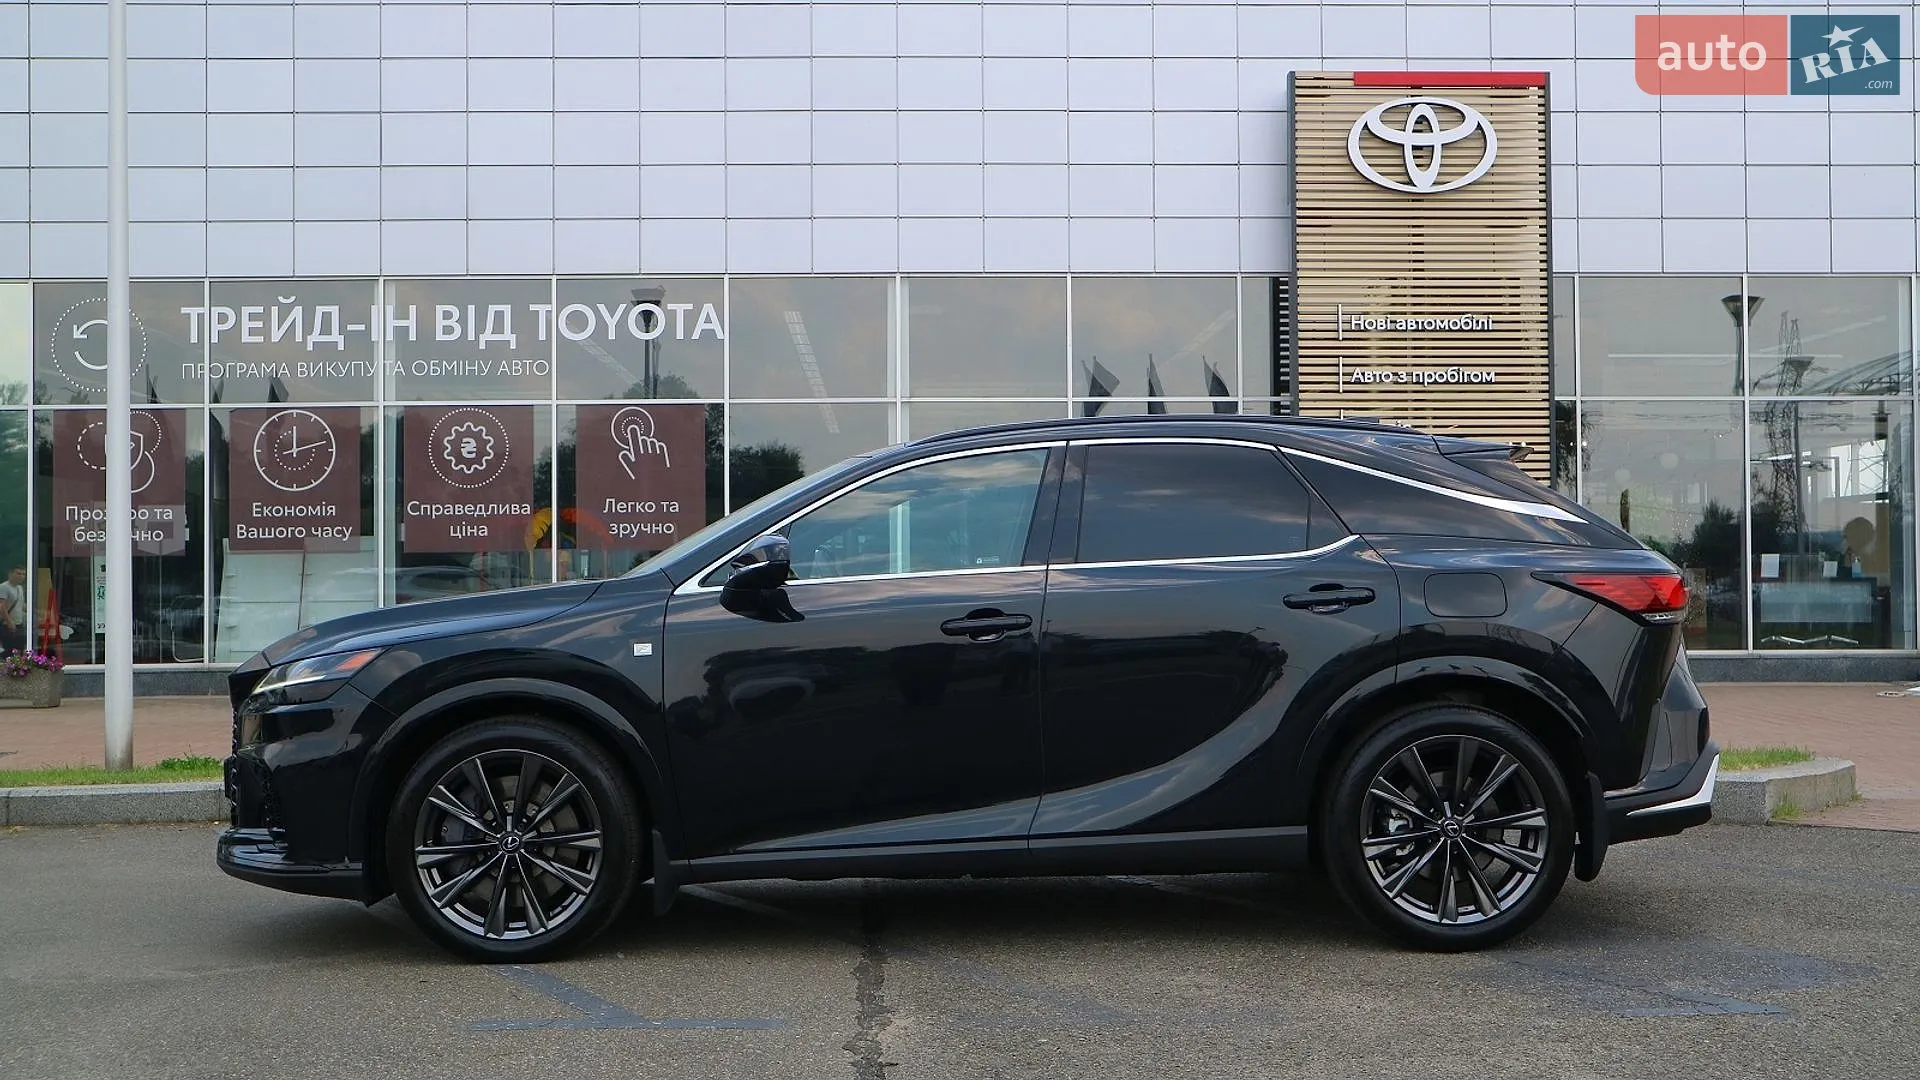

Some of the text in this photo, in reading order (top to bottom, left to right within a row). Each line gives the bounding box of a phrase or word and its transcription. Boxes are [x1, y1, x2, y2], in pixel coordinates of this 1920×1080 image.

[181, 295, 725, 351] ТРЕЙД-ІН ВІД TOYOTA
[1351, 314, 1493, 330] Нові автомобілі
[182, 359, 550, 379] ПРОГРАМА ВИКУПУ ТА ОБМІНУ АВТО
[1351, 366, 1496, 387] Авто з пробігом
[65, 505, 173, 524] Проо та
[252, 501, 336, 518] Економія
[406, 500, 531, 519] Справедлива
[603, 498, 680, 513] Легко та
[74, 526, 165, 542] безчно
[236, 523, 353, 541] Вашого часу
[449, 521, 488, 539] ціна
[608, 522, 675, 538] зручно
